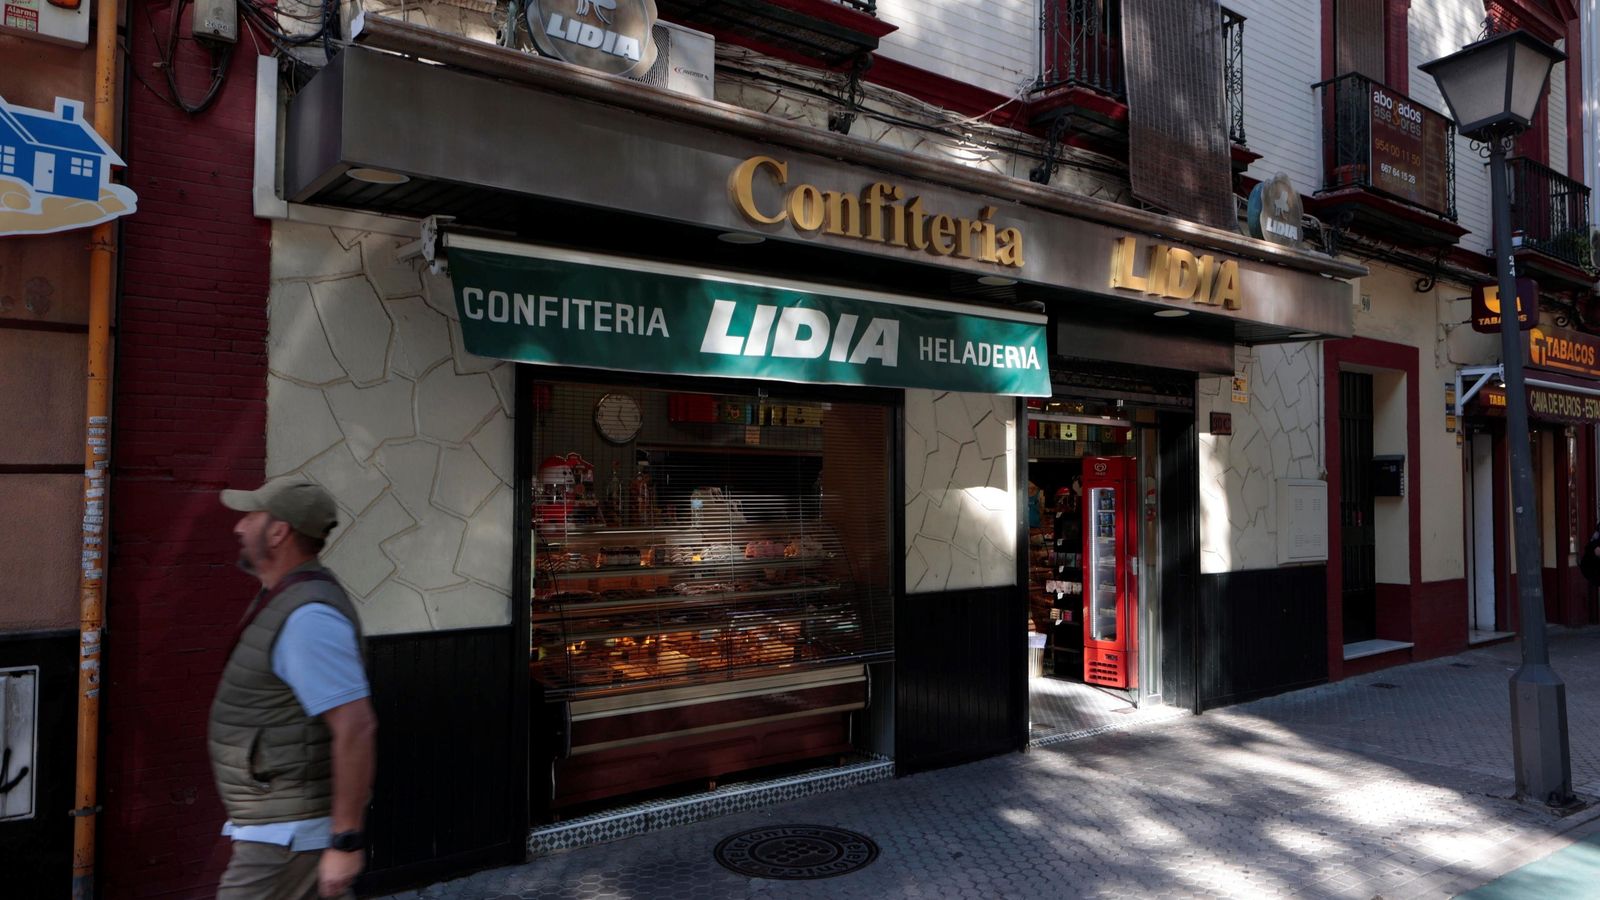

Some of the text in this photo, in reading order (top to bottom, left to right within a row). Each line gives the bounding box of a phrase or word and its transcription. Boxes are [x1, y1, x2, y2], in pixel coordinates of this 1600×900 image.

[546, 12, 640, 62] LIDIA
[728, 156, 1025, 267] Confitería
[1265, 216, 1298, 240] LIDIA
[1110, 236, 1241, 310] LIDIA
[462, 286, 1041, 370] CONFITERIA LIDIA HELADERIA
[1545, 336, 1595, 366] TABACOS
[1530, 390, 1548, 413] CAVA
[1548, 392, 1558, 414] DE
[1558, 394, 1581, 417] PUROS
